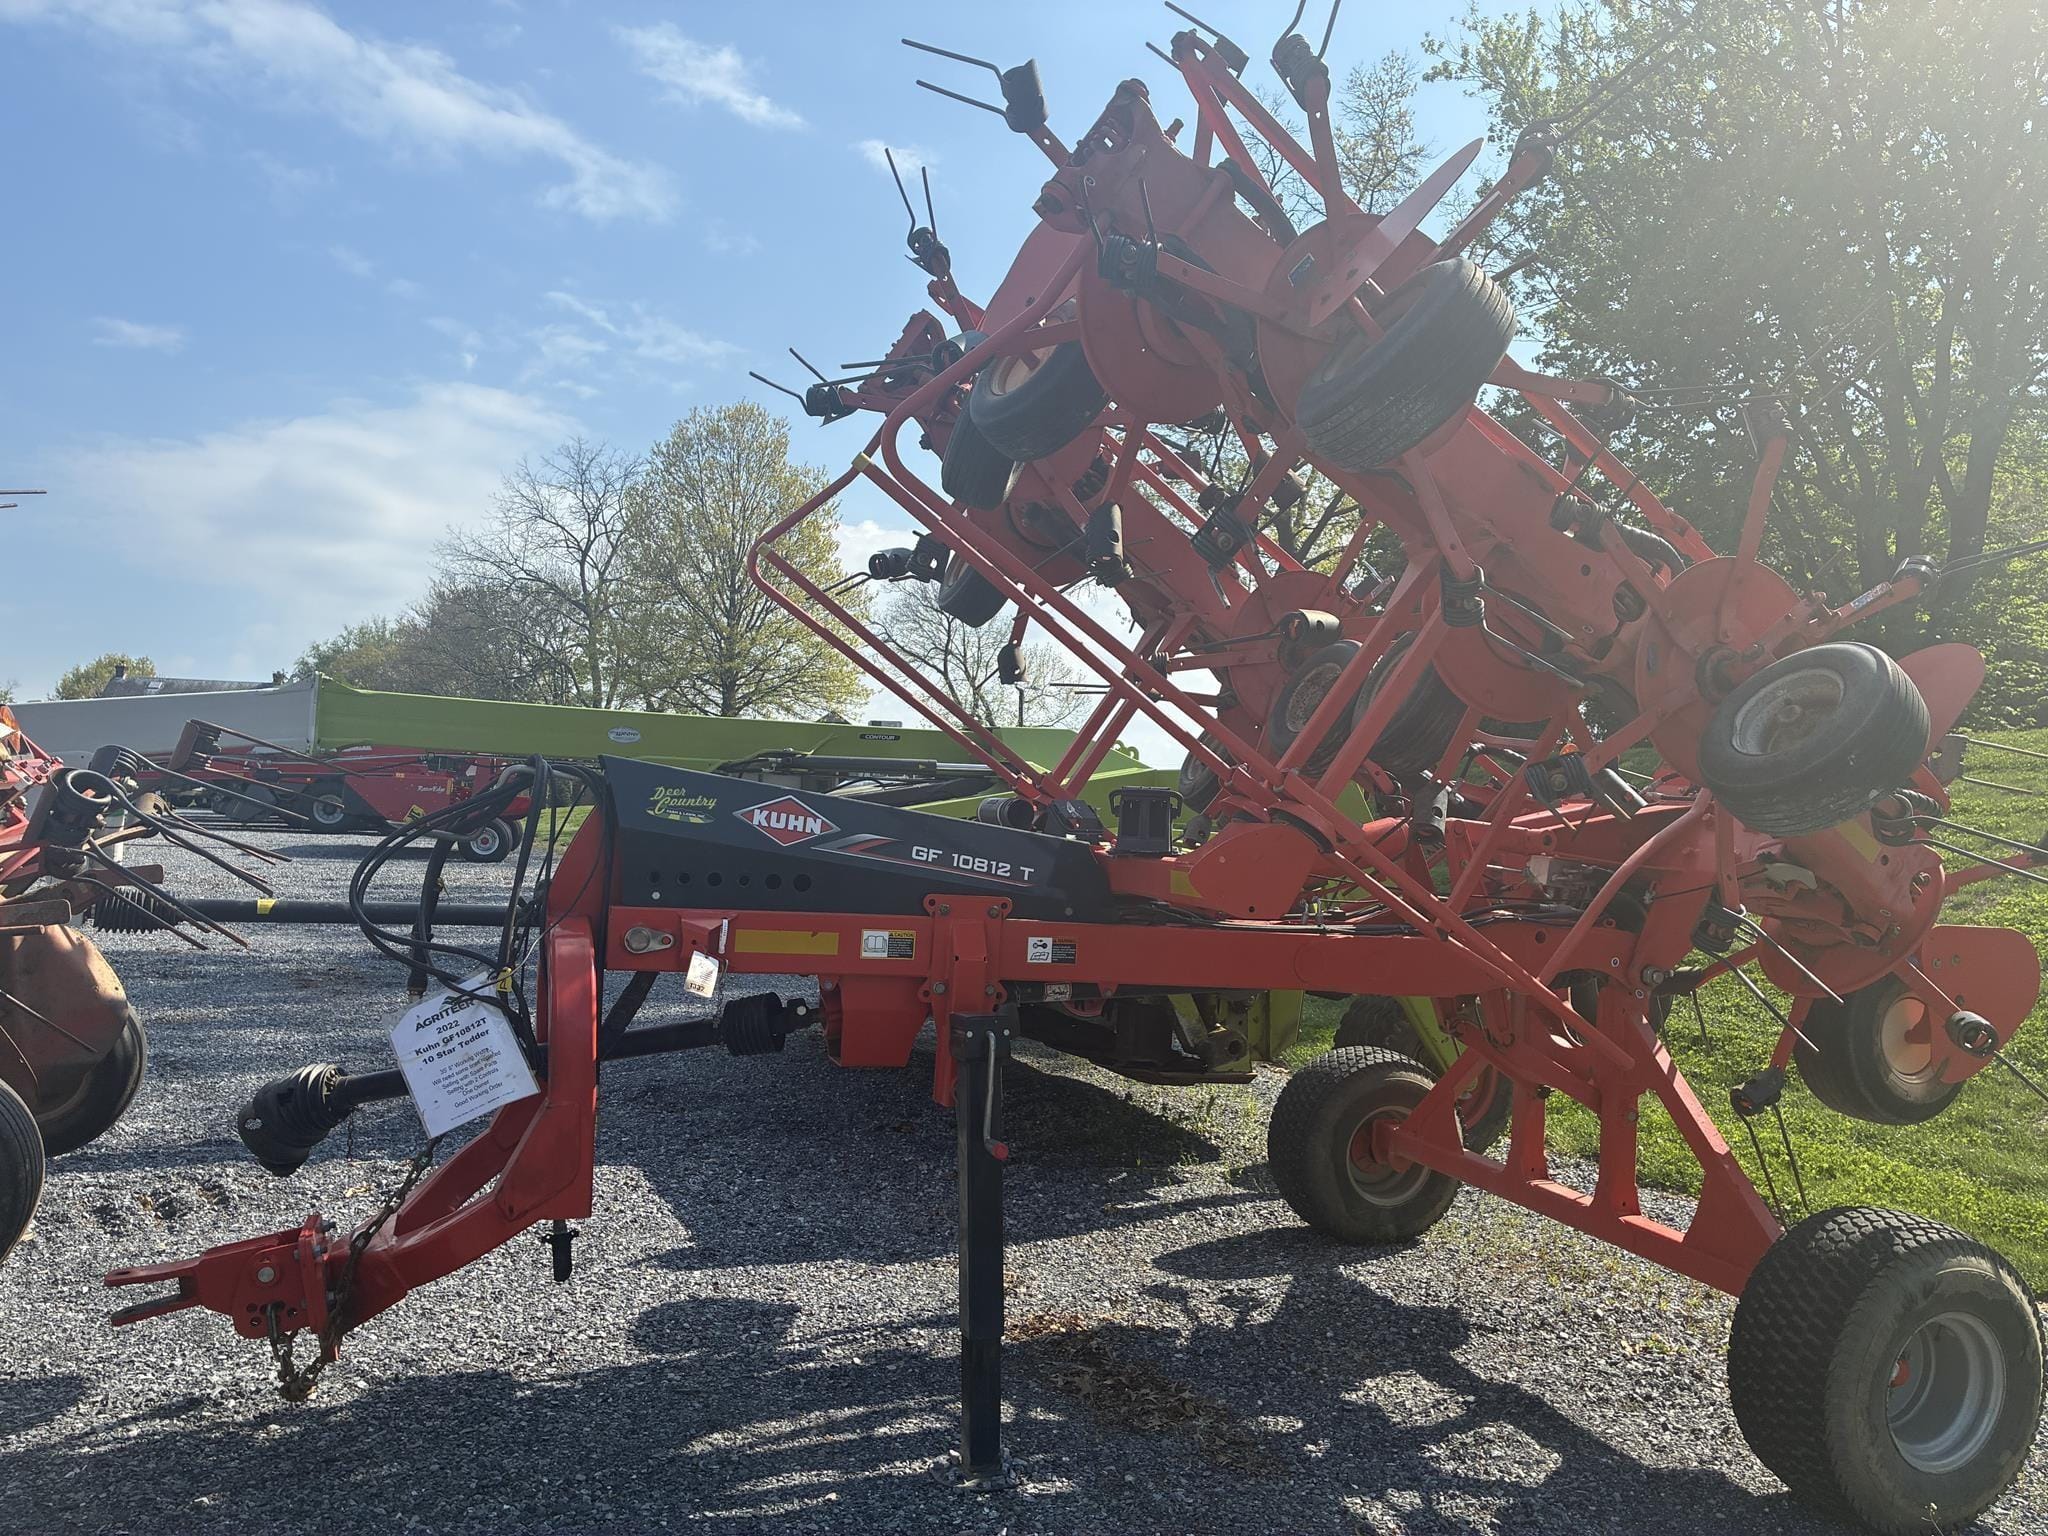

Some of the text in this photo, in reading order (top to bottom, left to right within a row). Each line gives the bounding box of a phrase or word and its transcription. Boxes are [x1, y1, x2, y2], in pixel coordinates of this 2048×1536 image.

[650, 786, 686, 801] Deer
[655, 795, 717, 814] Country
[753, 809, 822, 834] KUHN
[912, 845, 1035, 881] GF 10812 T
[415, 1017, 487, 1056] Kuhn GF10812T
[436, 1020, 460, 1034] 2022
[422, 1029, 490, 1065] 10 Star Tedder
[453, 1080, 503, 1108] Good Working Order
